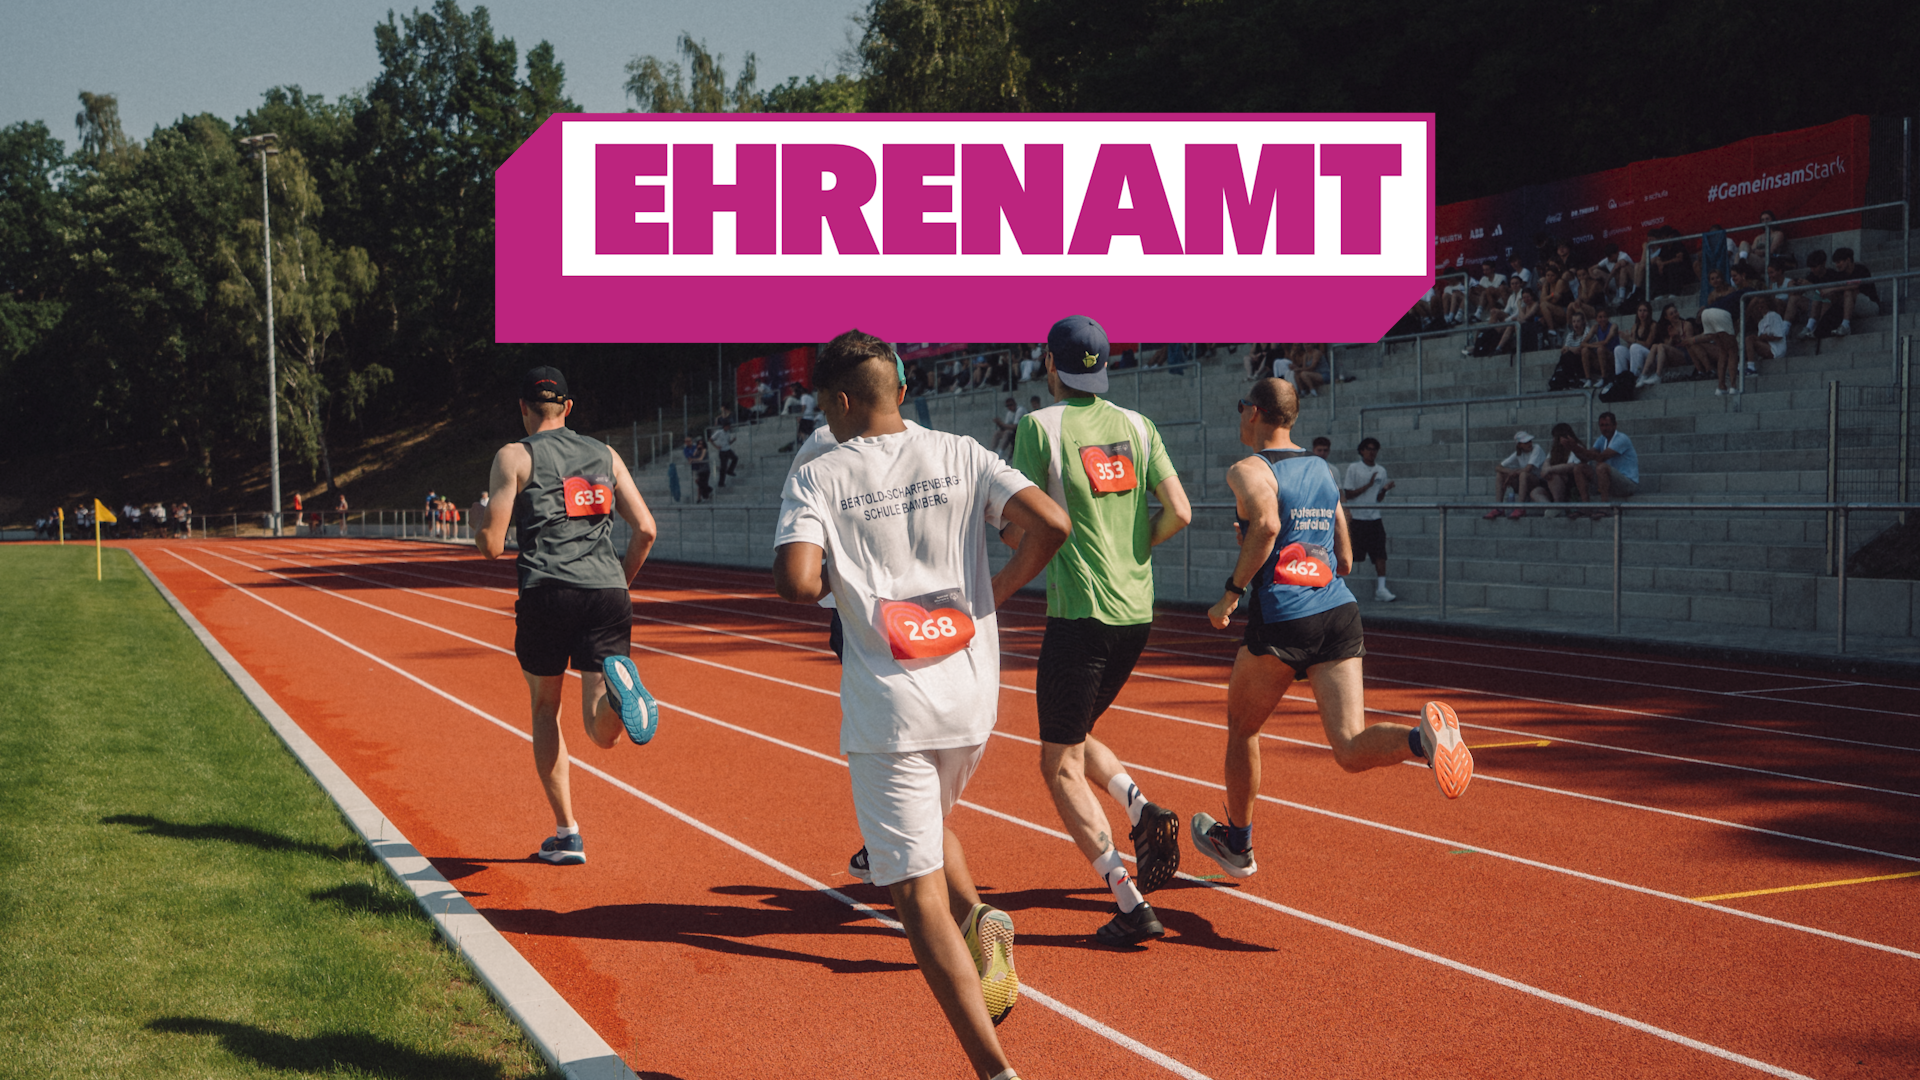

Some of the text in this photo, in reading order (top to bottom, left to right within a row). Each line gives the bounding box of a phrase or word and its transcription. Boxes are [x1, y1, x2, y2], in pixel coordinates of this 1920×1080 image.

[1707, 155, 1846, 202] #GemeinsamStark
[1572, 233, 1595, 245] TOYOTA
[1096, 460, 1125, 480] 353
[574, 489, 605, 506] 635
[840, 475, 962, 511] BERTOLD-SCHARFENBERG-
[864, 492, 948, 521] SCHULE BAMBERG
[1286, 559, 1320, 577] 462
[903, 616, 957, 641] 268
